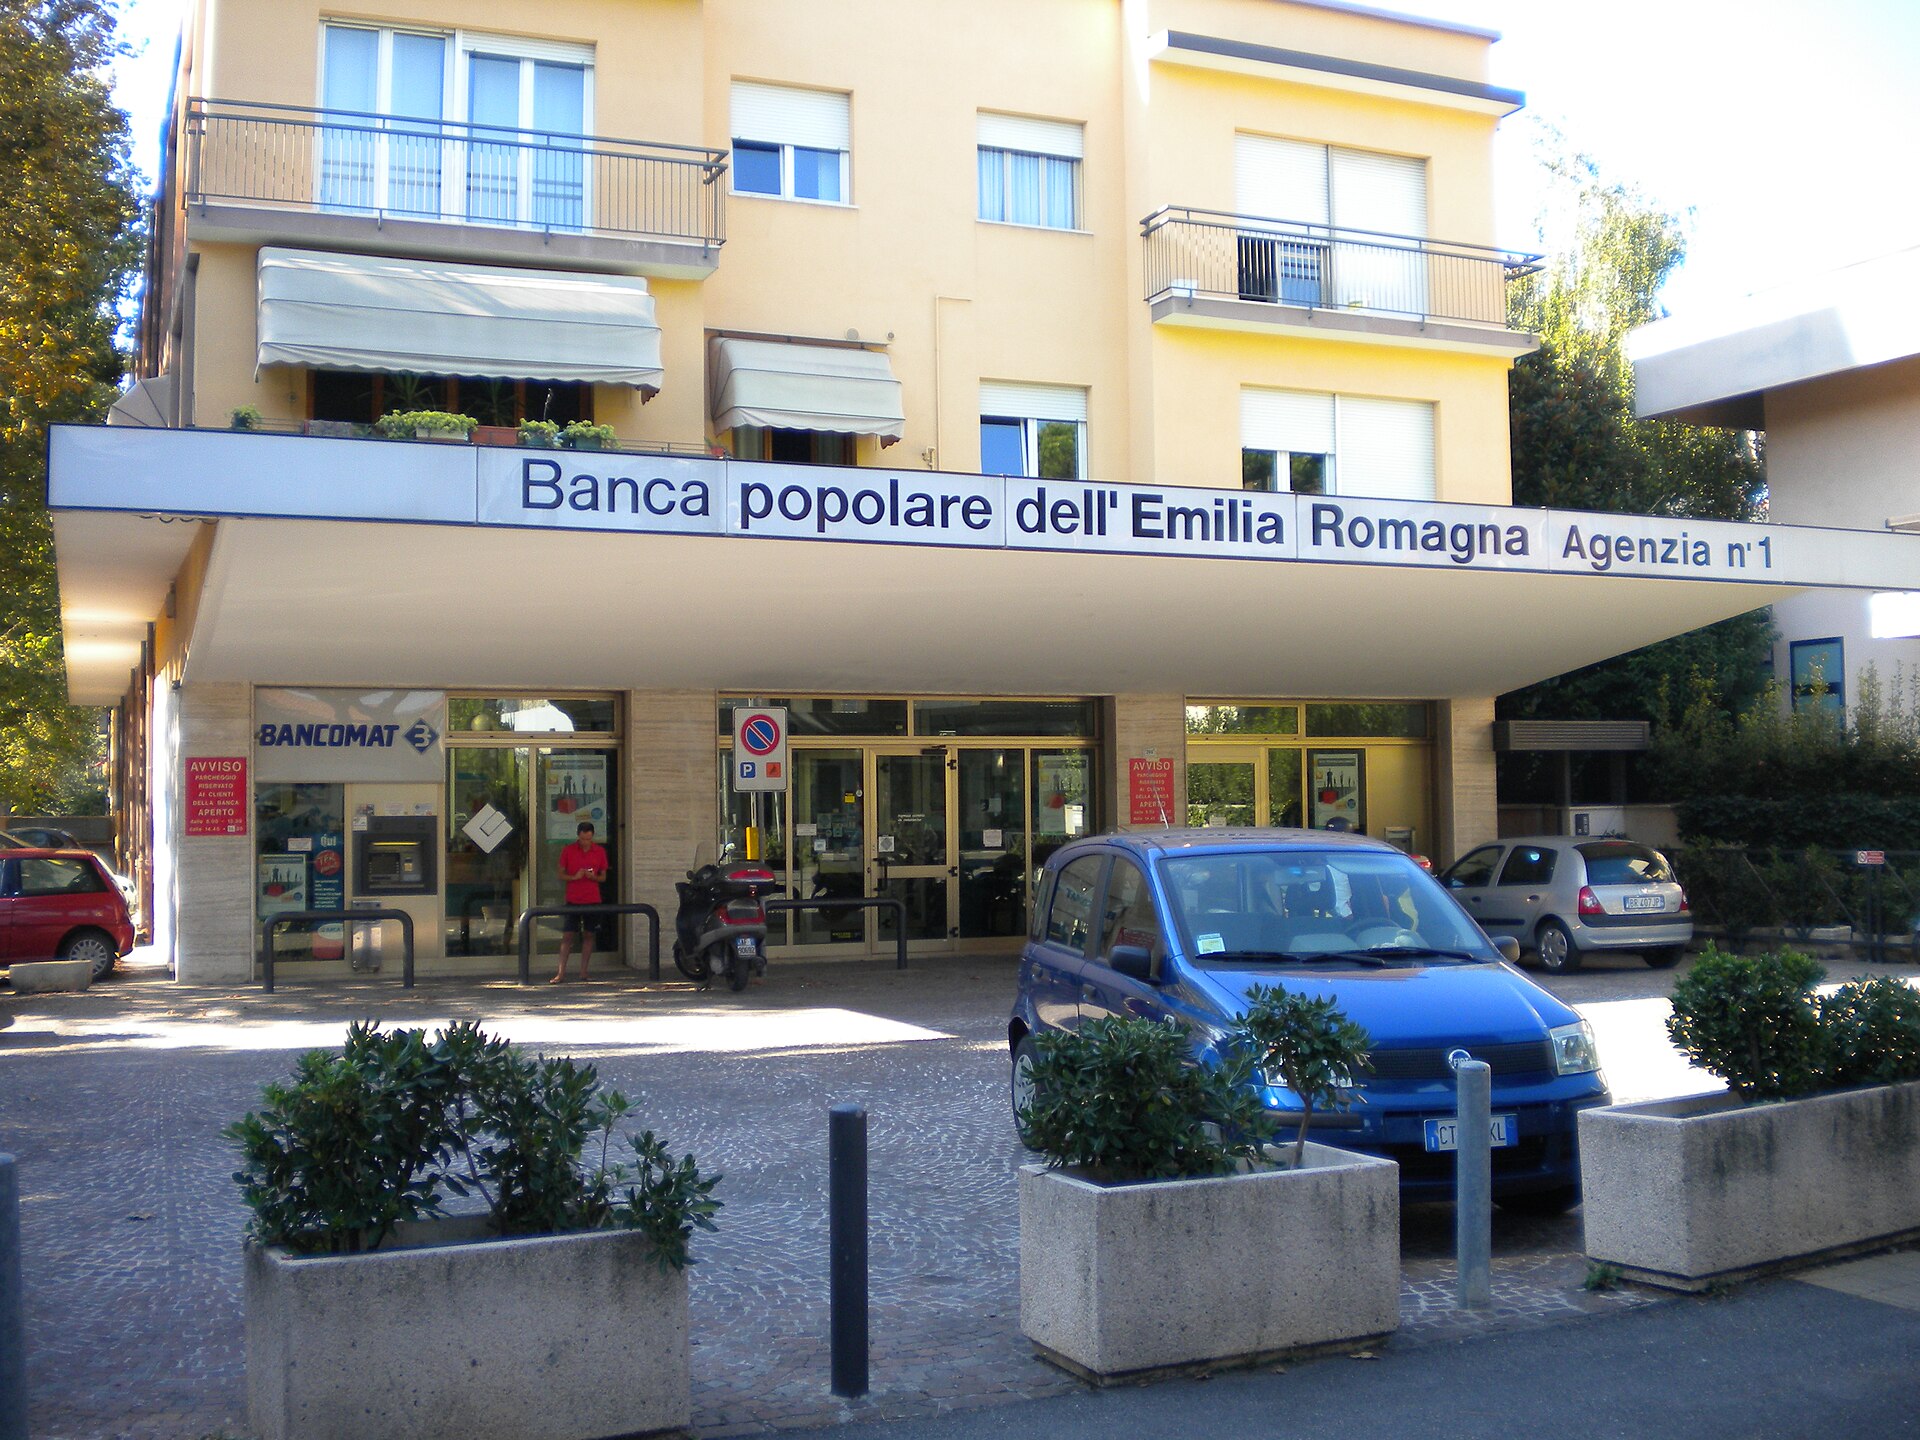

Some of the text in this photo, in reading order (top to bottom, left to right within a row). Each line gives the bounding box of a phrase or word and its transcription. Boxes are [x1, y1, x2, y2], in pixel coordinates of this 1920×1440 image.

[522, 458, 711, 517] Banca
[740, 478, 993, 533] popolare
[1016, 487, 1118, 536] dell'
[1132, 493, 1285, 544] Emilia
[1311, 503, 1531, 564] Romagna
[1562, 524, 1711, 571] Agenzia
[259, 723, 400, 747] BANCOMAT
[190, 761, 242, 772] AVVISO
[743, 764, 753, 777] P
[1133, 761, 1171, 771] AVVISO
[198, 808, 235, 816] APERTO
[1439, 1126, 1456, 1145] CT
